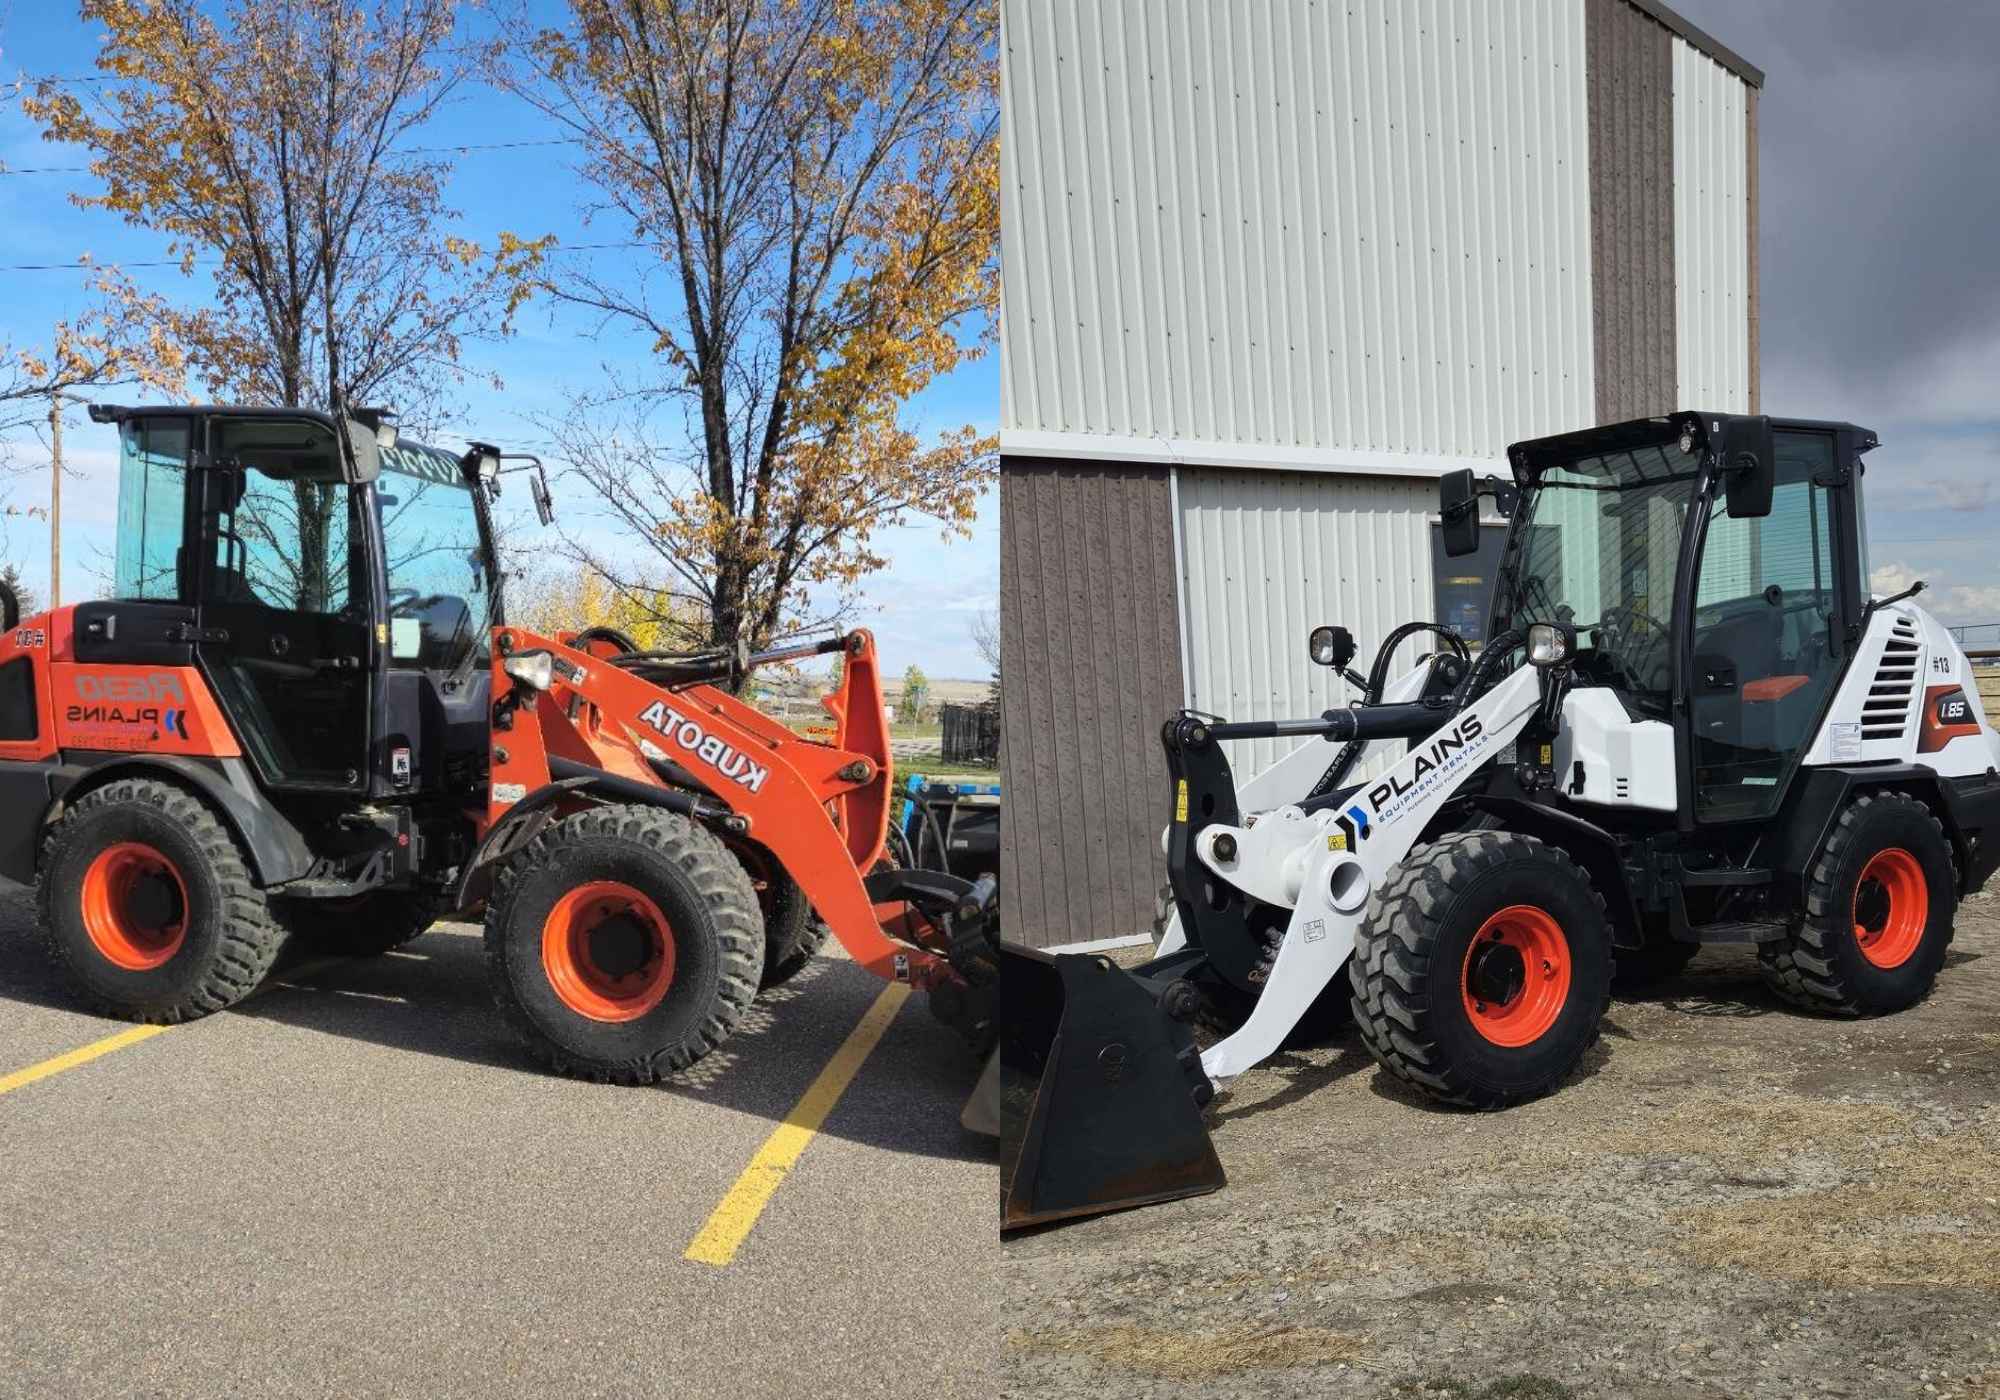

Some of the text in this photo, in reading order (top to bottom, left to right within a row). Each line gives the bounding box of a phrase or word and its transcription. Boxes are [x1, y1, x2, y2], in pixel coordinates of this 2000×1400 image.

[1933, 656, 1950, 673] #13
[1368, 713, 1483, 814] PLAINS
[1378, 772, 1438, 823] EQUIPMENT
[1442, 735, 1489, 772] RENTALS
